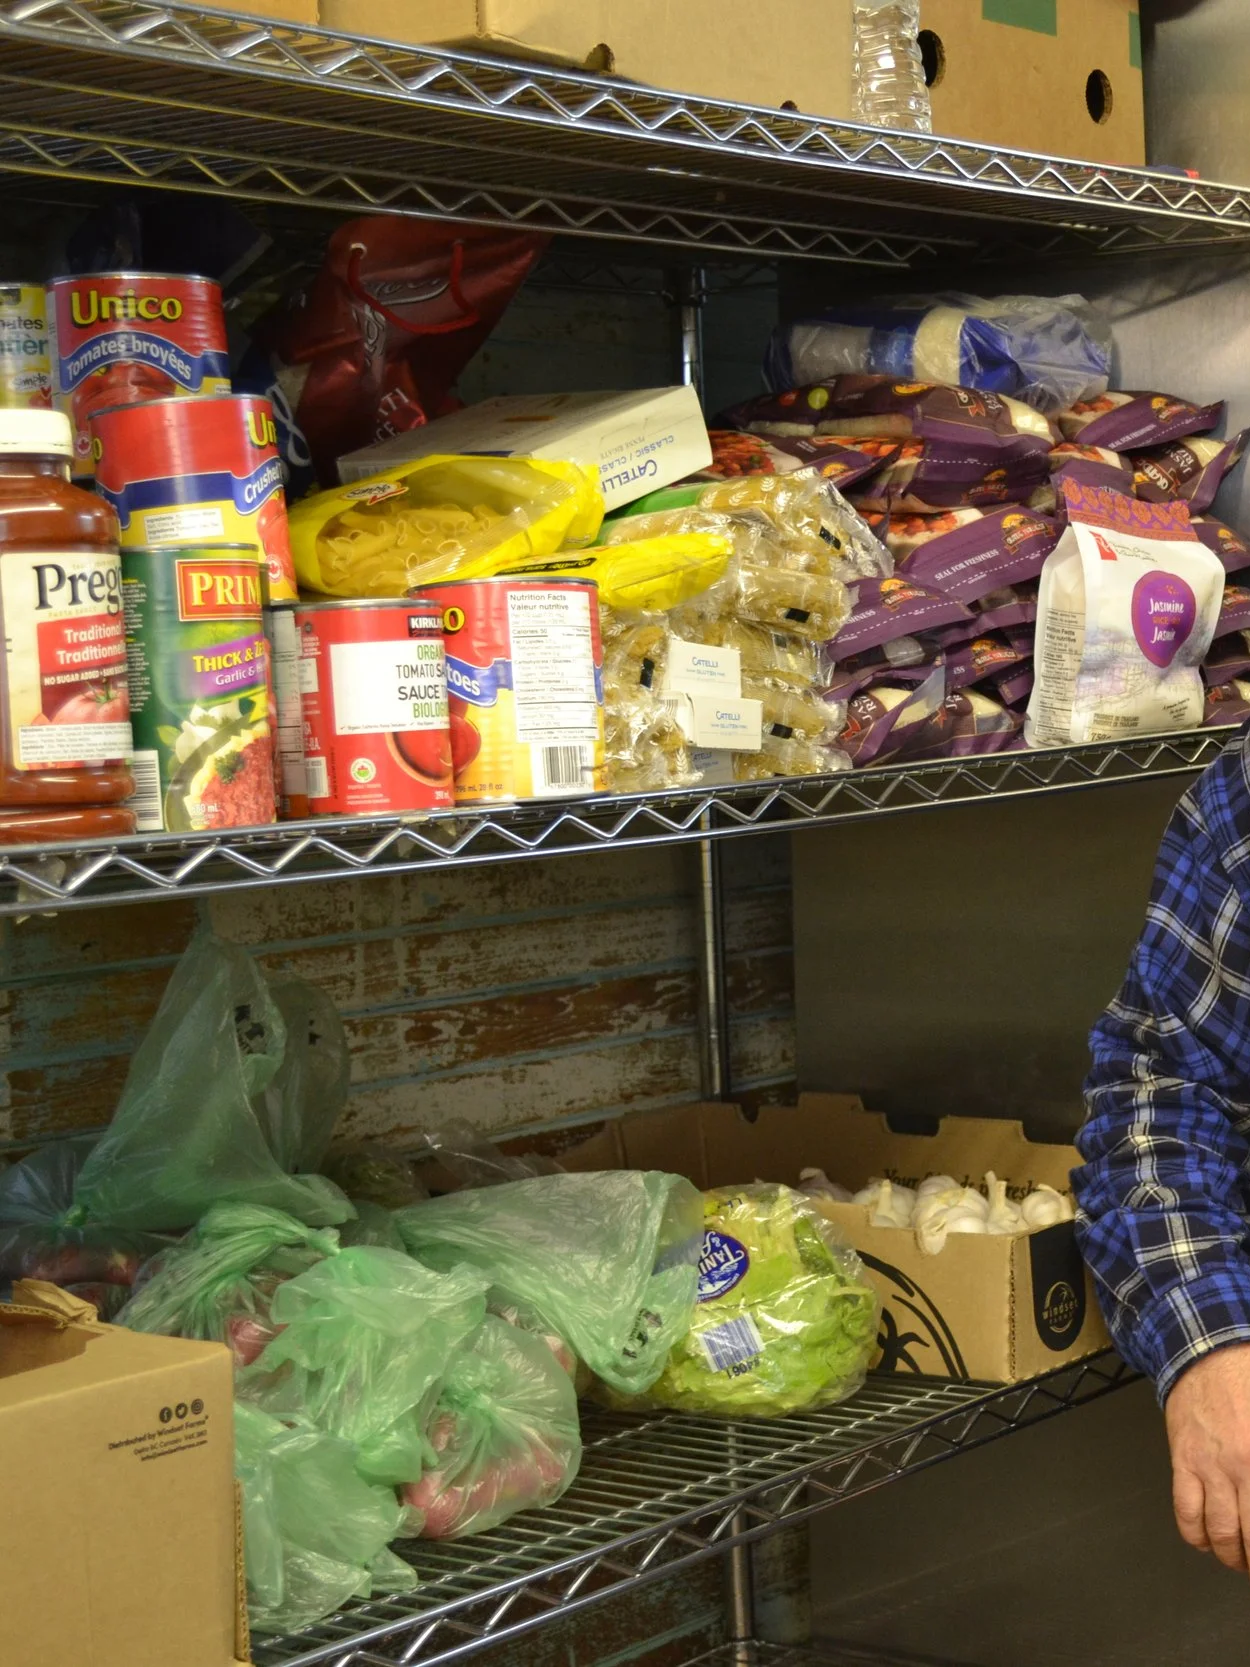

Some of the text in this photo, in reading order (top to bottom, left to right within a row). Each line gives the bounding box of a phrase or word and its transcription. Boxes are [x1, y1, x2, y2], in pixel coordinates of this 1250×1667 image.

[71, 286, 183, 326] Unico
[66, 336, 192, 382] Tomates broyées
[634, 434, 675, 458] CLASSIC
[601, 460, 658, 493] CATELLI
[933, 549, 1000, 581] SEAL FOR FRESHNESS
[509, 593, 567, 601] Nutrition Facts
[510, 603, 569, 611] Valeur nutritive
[1147, 597, 1185, 615] Jasmine
[192, 650, 243, 673] THICK
[244, 647, 254, 662] &
[692, 656, 719, 668] CATELLI
[43, 676, 56, 686] NO
[56, 673, 80, 685] SUGAR
[215, 669, 247, 686] Garlic
[395, 663, 435, 679] TOMATO
[397, 684, 440, 701] SAUCE
[715, 710, 741, 721] CATELLI
